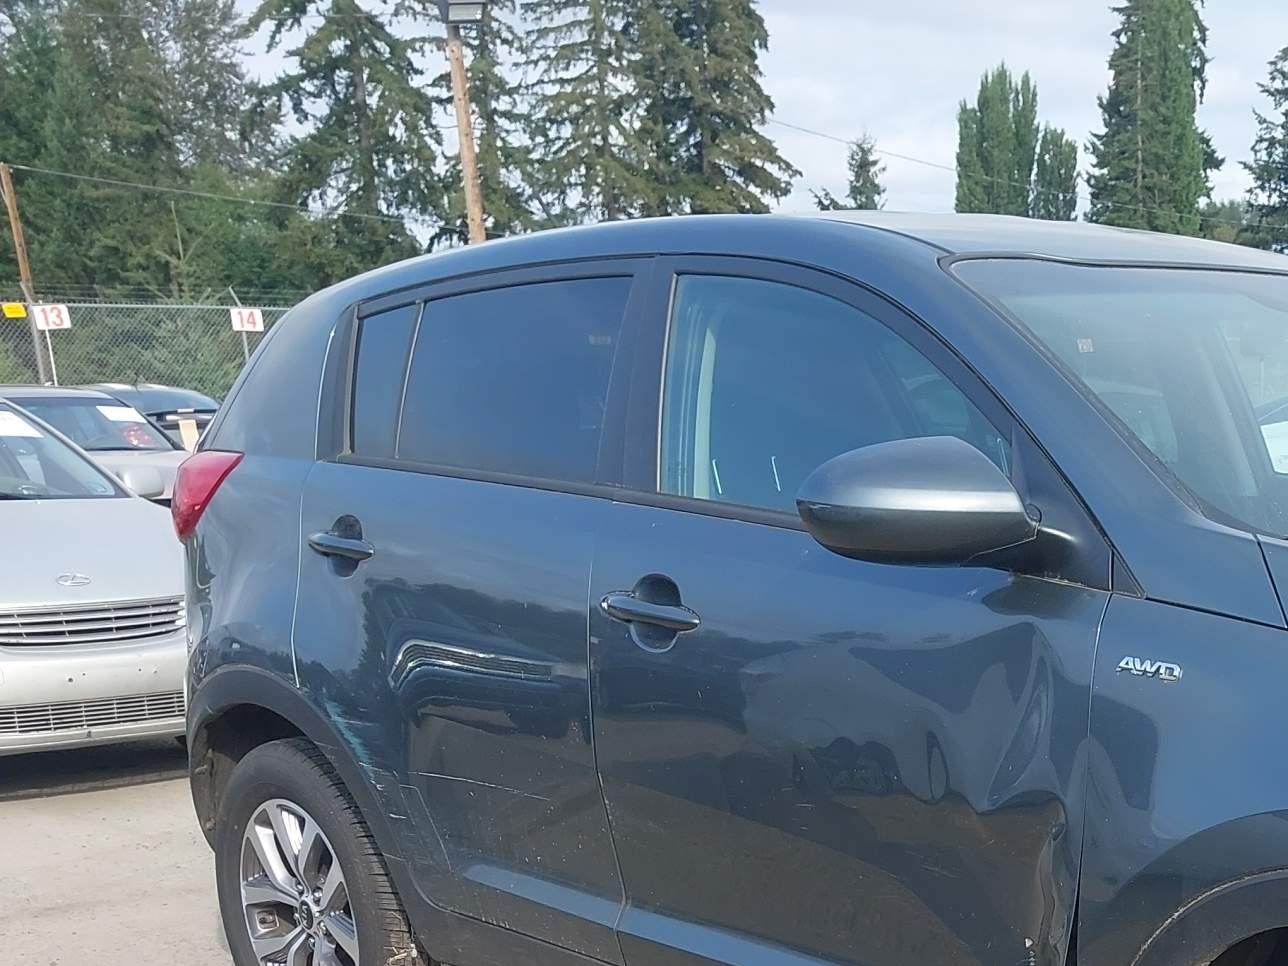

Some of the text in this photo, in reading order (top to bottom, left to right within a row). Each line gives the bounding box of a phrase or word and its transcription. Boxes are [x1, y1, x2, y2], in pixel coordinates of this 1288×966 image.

[40, 307, 64, 327] 13
[237, 311, 256, 329] 14
[1115, 656, 1182, 681] AWD
